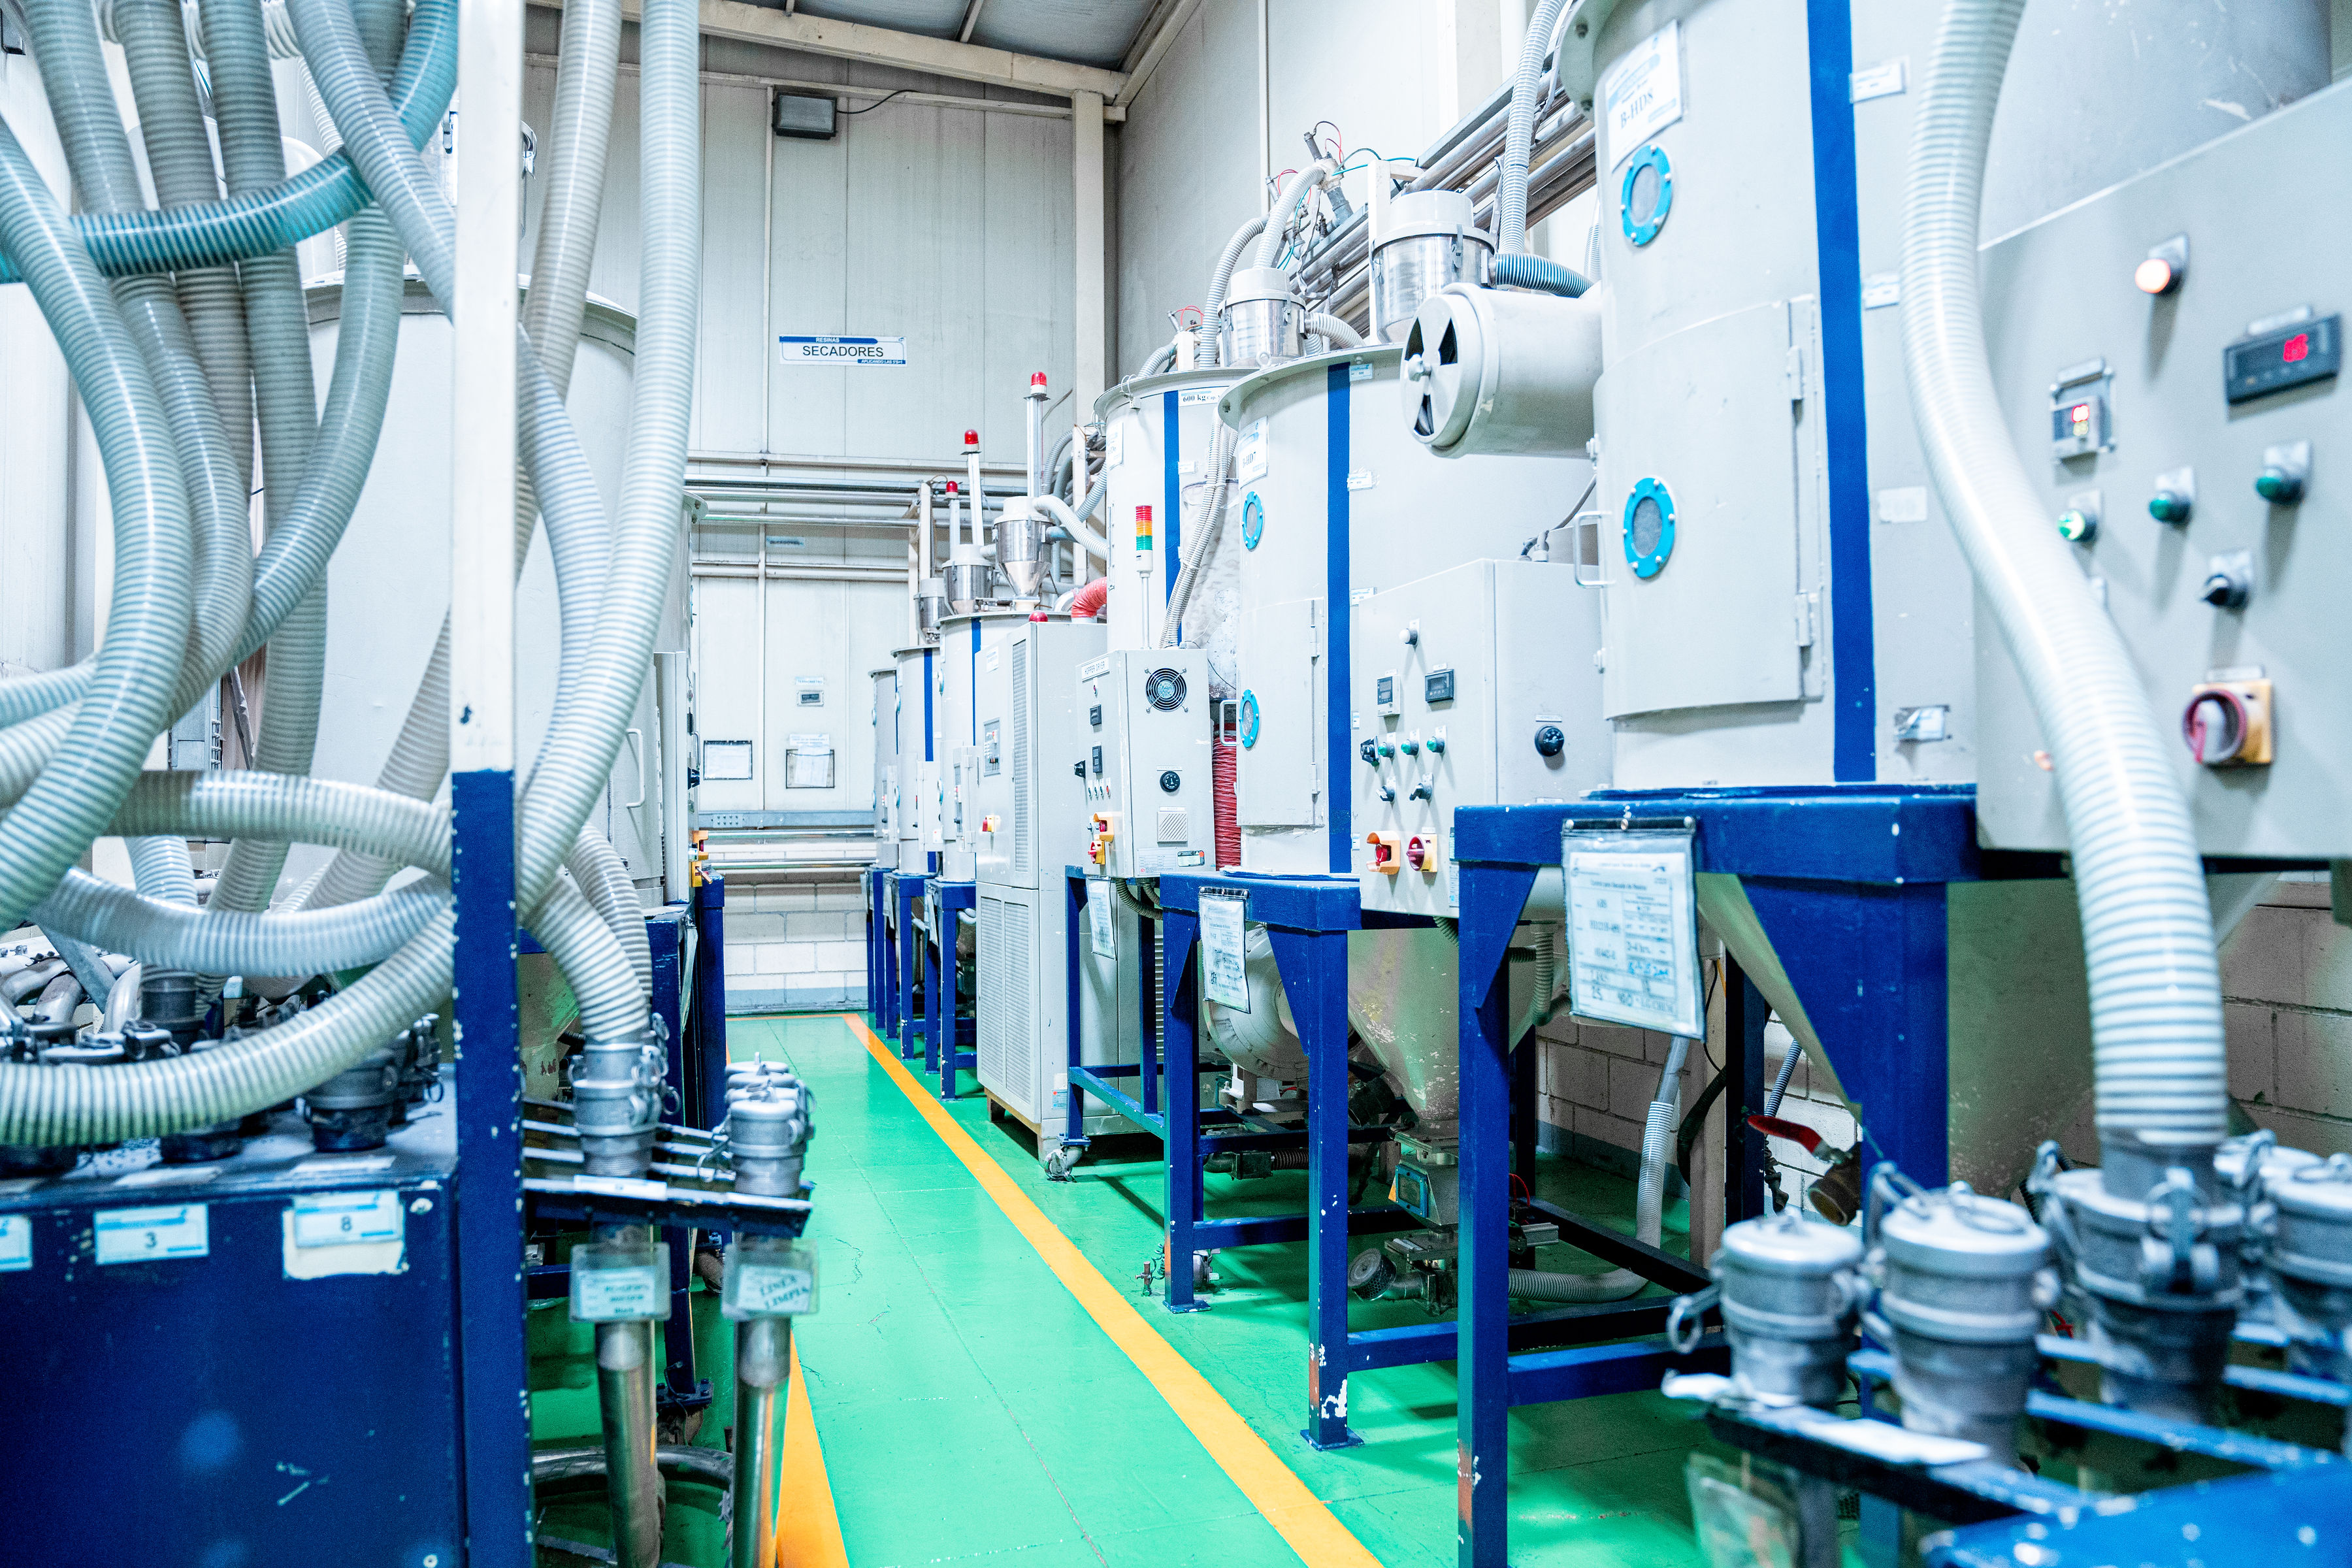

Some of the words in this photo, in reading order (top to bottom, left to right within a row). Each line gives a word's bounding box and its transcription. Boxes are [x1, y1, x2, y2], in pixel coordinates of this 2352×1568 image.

[802, 346, 884, 357] SECADORES
[341, 1215, 352, 1232] 8
[145, 1232, 157, 1249] 3
